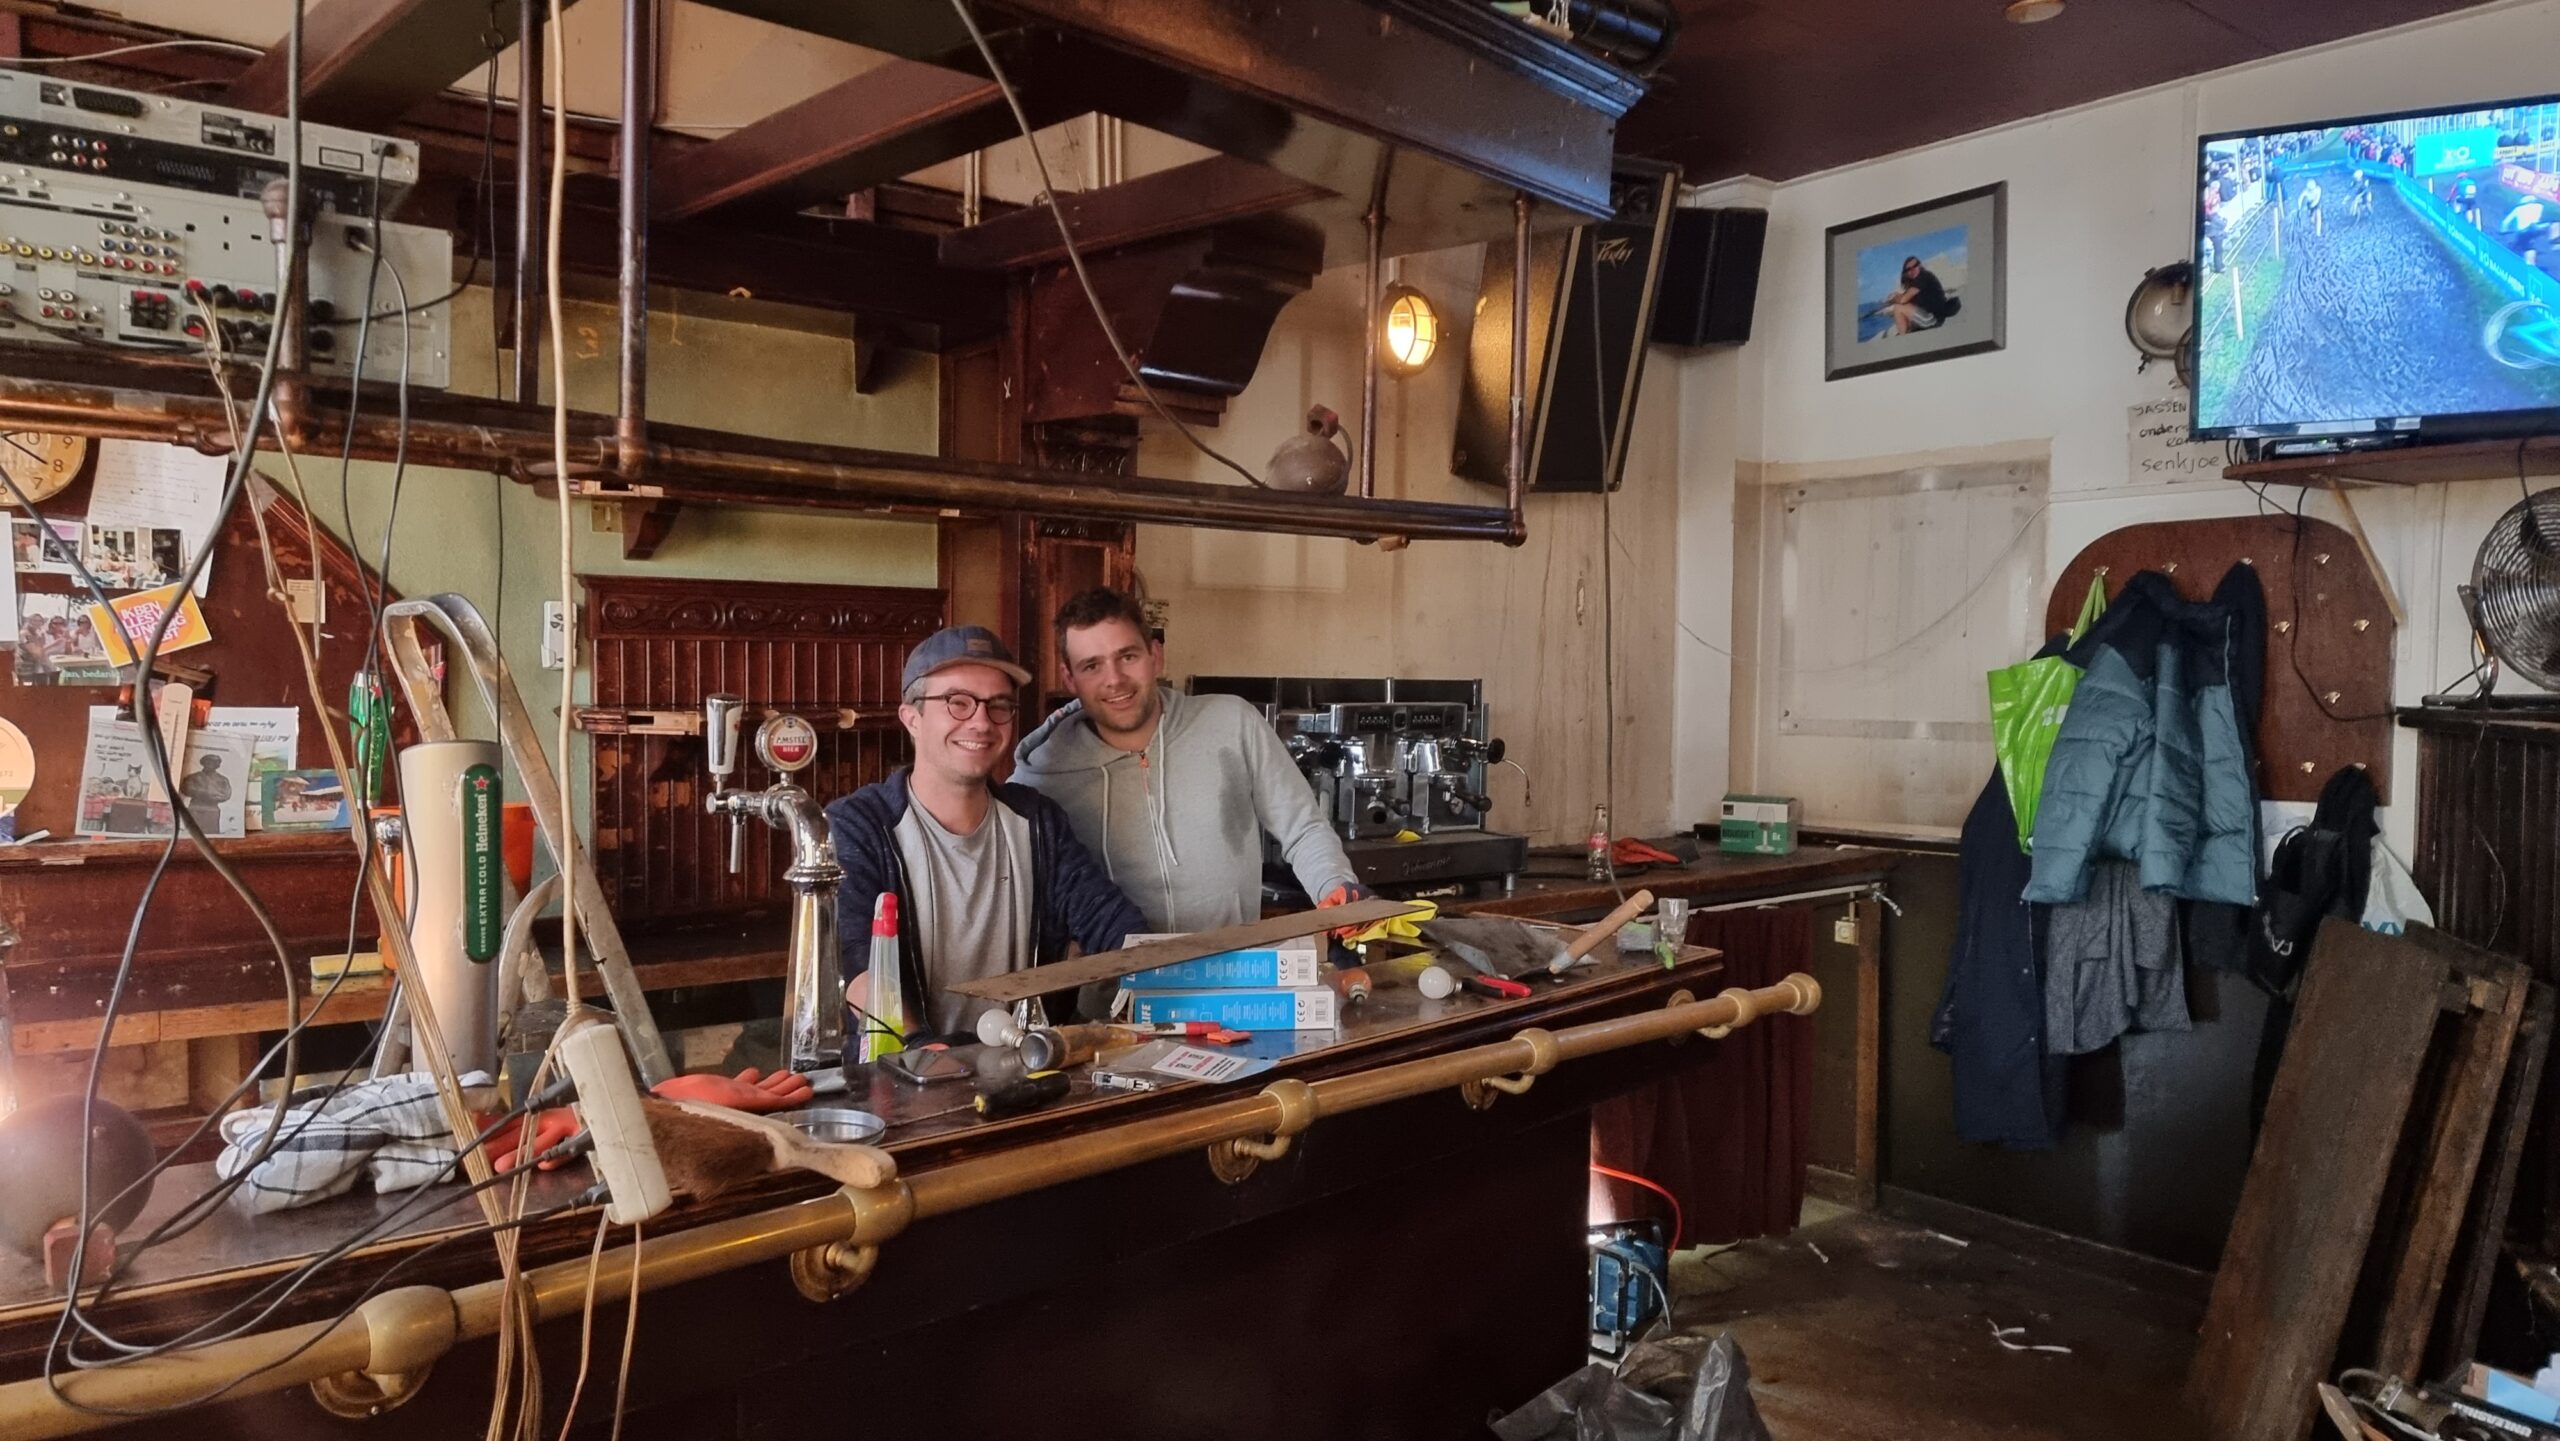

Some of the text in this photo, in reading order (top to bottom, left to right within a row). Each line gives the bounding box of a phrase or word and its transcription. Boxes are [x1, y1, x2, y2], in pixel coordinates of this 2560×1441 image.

[53, 458, 64, 473] 8
[32, 475, 44, 490] 7
[776, 735, 807, 744] AMSTEL
[475, 793, 489, 852] Heineken
[478, 856, 487, 885] COLD
[479, 888, 487, 924] EXTRA
